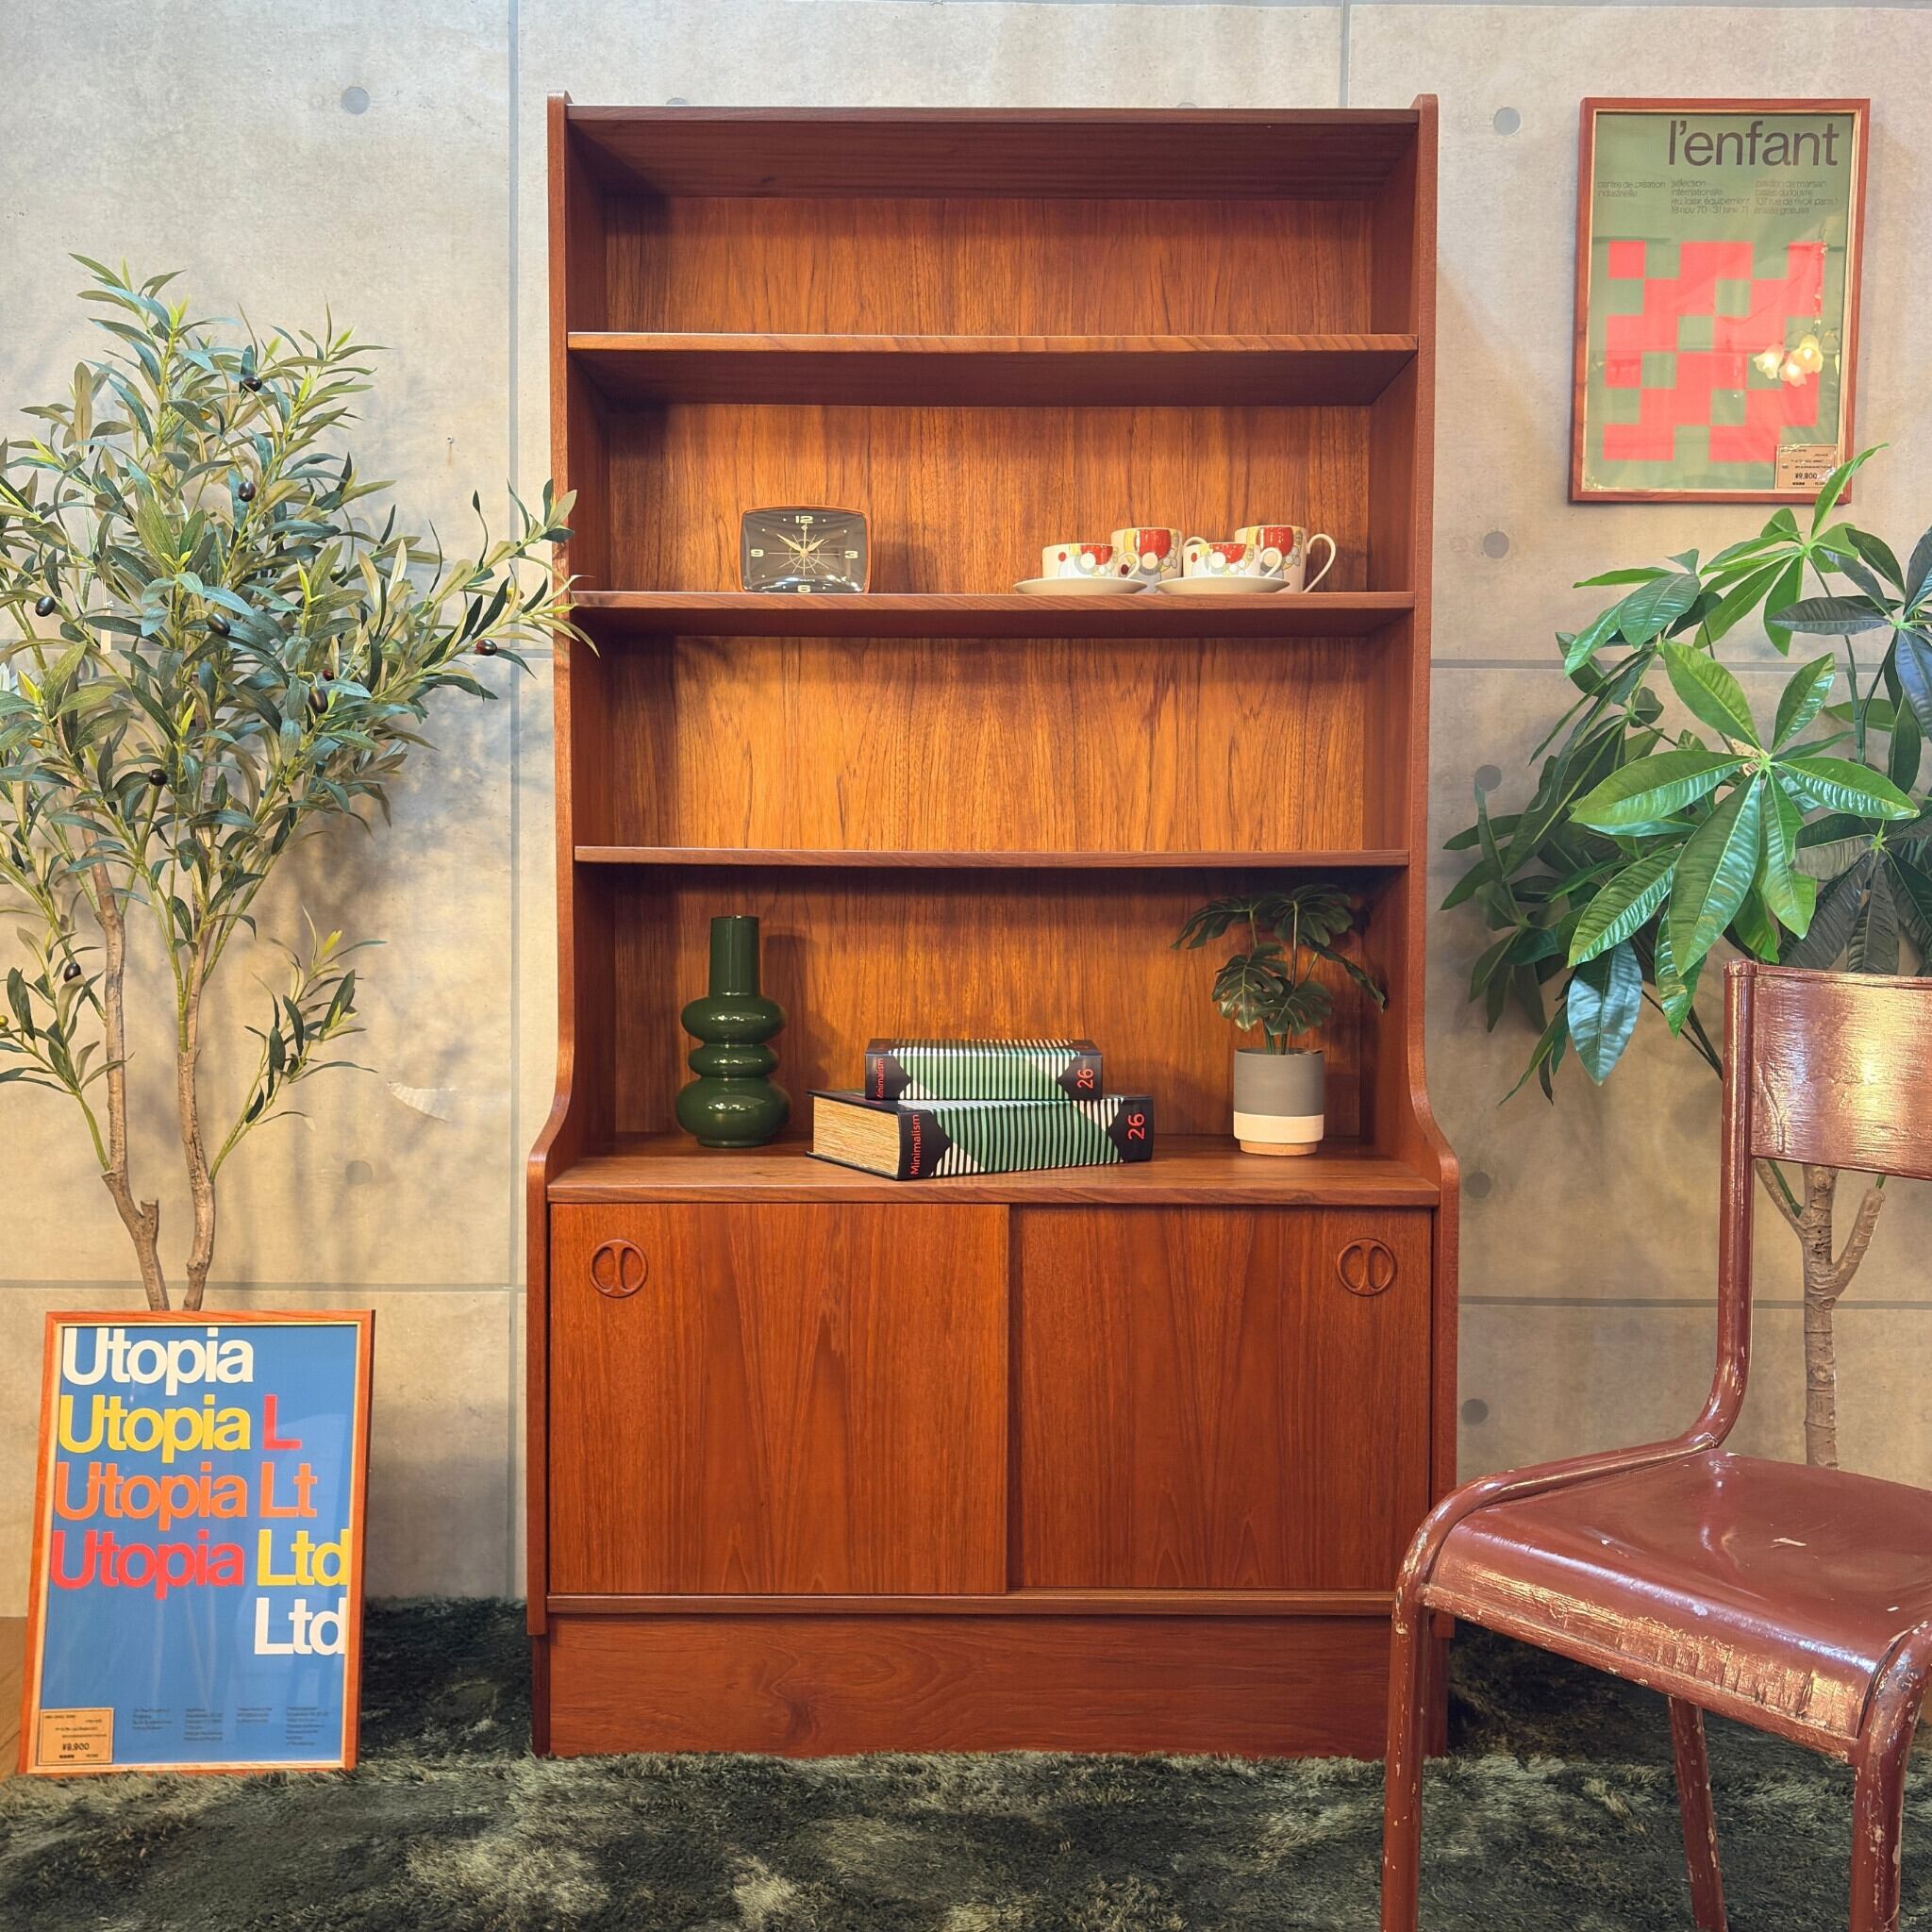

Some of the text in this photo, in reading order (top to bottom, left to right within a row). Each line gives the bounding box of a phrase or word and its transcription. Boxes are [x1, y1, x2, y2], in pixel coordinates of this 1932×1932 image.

[795, 515, 814, 525] 12
[750, 548, 765, 558] 9
[844, 550, 858, 559] 3
[797, 584, 811, 593] 6
[1076, 1068, 1094, 1090] 26
[909, 1114, 922, 1175] Minimalism
[1127, 1112, 1146, 1141] 26
[62, 1327, 255, 1396] Utopia
[58, 1394, 303, 1464] Utopia L
[54, 1461, 318, 1532] Utopia Lt
[49, 1528, 351, 1601] Utopia Ltd
[254, 1597, 348, 1656] Ltd
